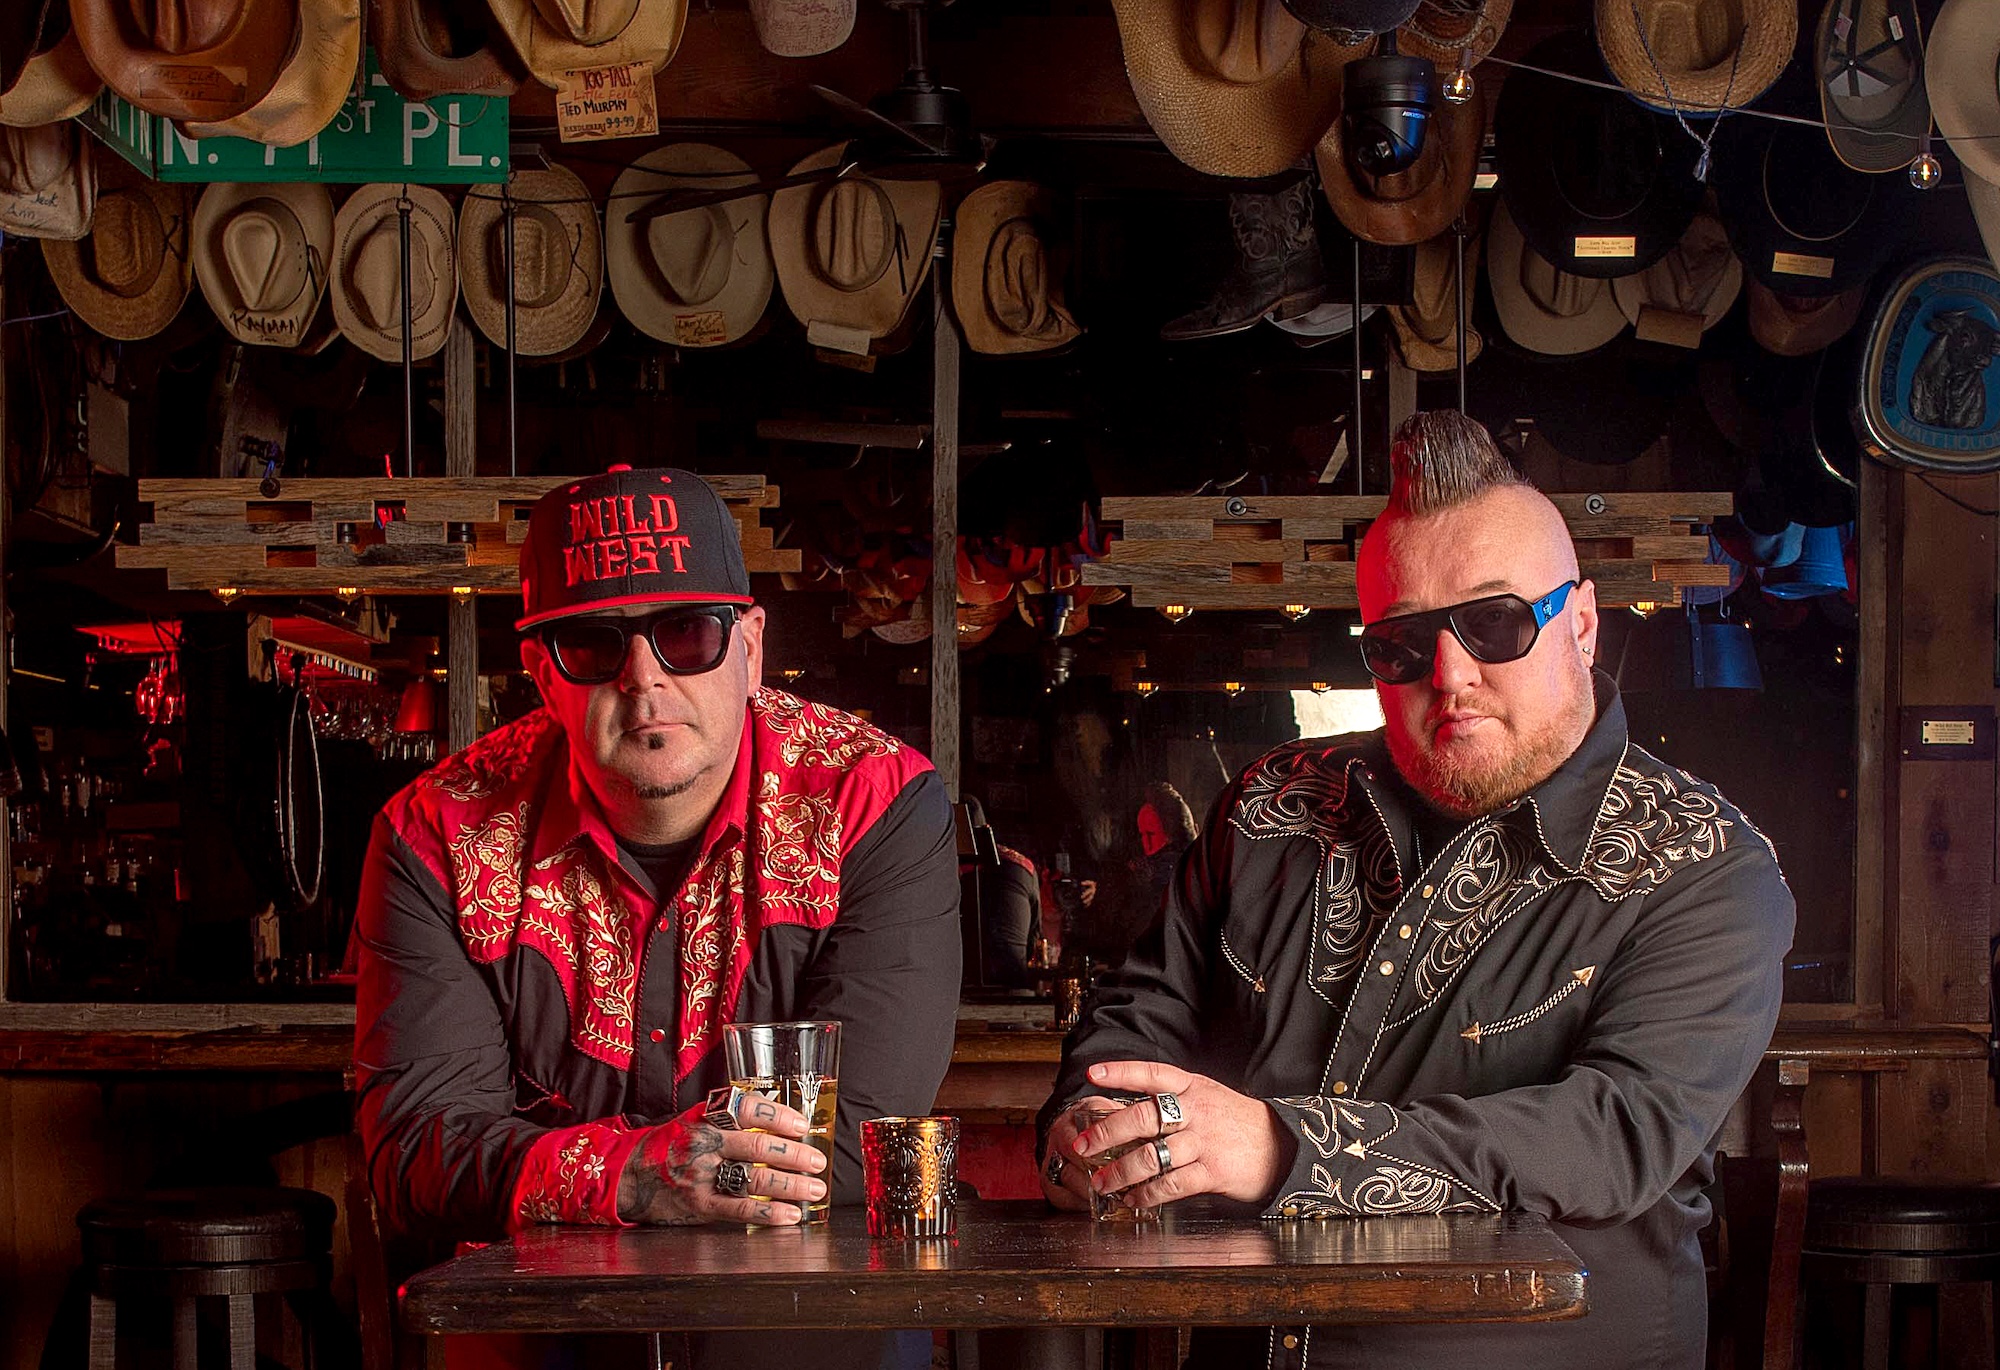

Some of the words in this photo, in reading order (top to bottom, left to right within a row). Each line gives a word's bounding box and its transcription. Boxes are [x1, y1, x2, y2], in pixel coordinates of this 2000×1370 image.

[583, 99, 627, 115] MURPHY
[403, 102, 502, 167] PL.
[568, 493, 679, 544] WILD
[563, 535, 692, 588] WEST
